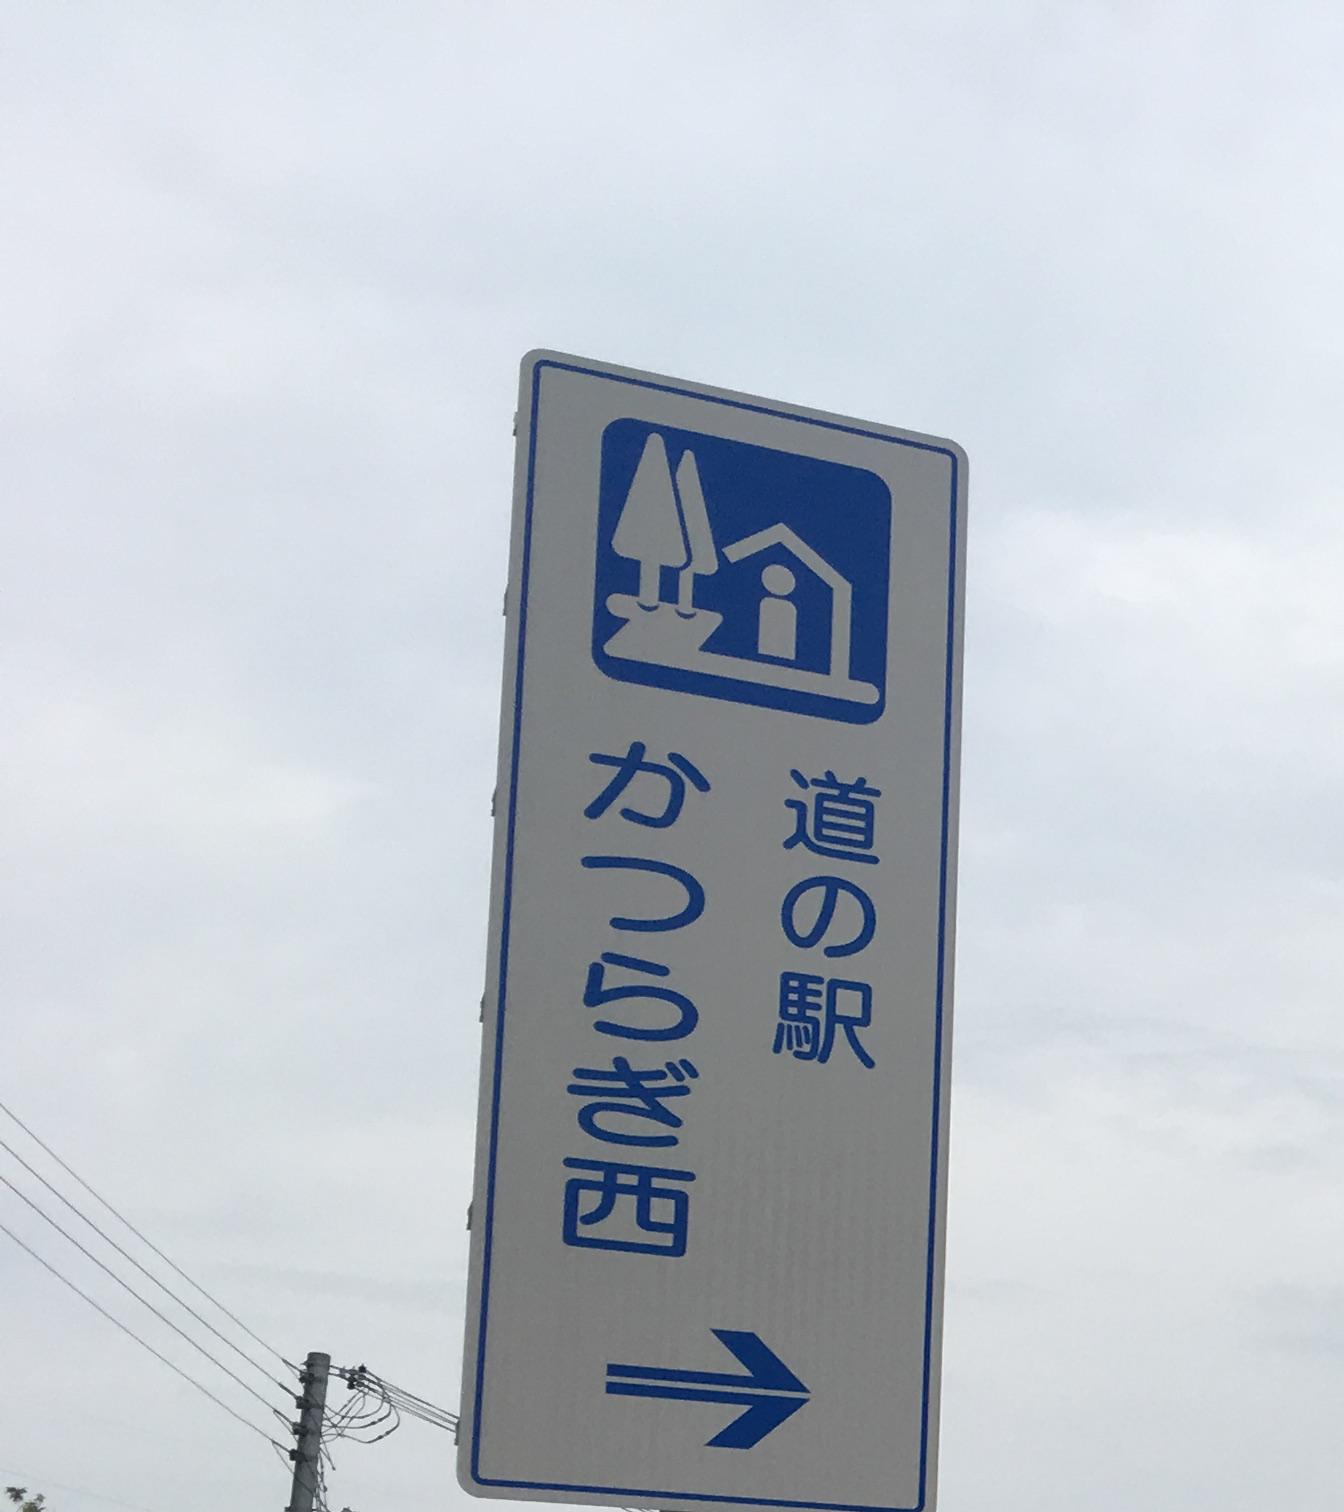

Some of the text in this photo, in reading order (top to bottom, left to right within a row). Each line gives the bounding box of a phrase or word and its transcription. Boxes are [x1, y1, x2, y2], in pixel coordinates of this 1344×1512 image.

[562, 740, 712, 1259] かつらぎ西
[771, 767, 882, 1070] 道の駅
